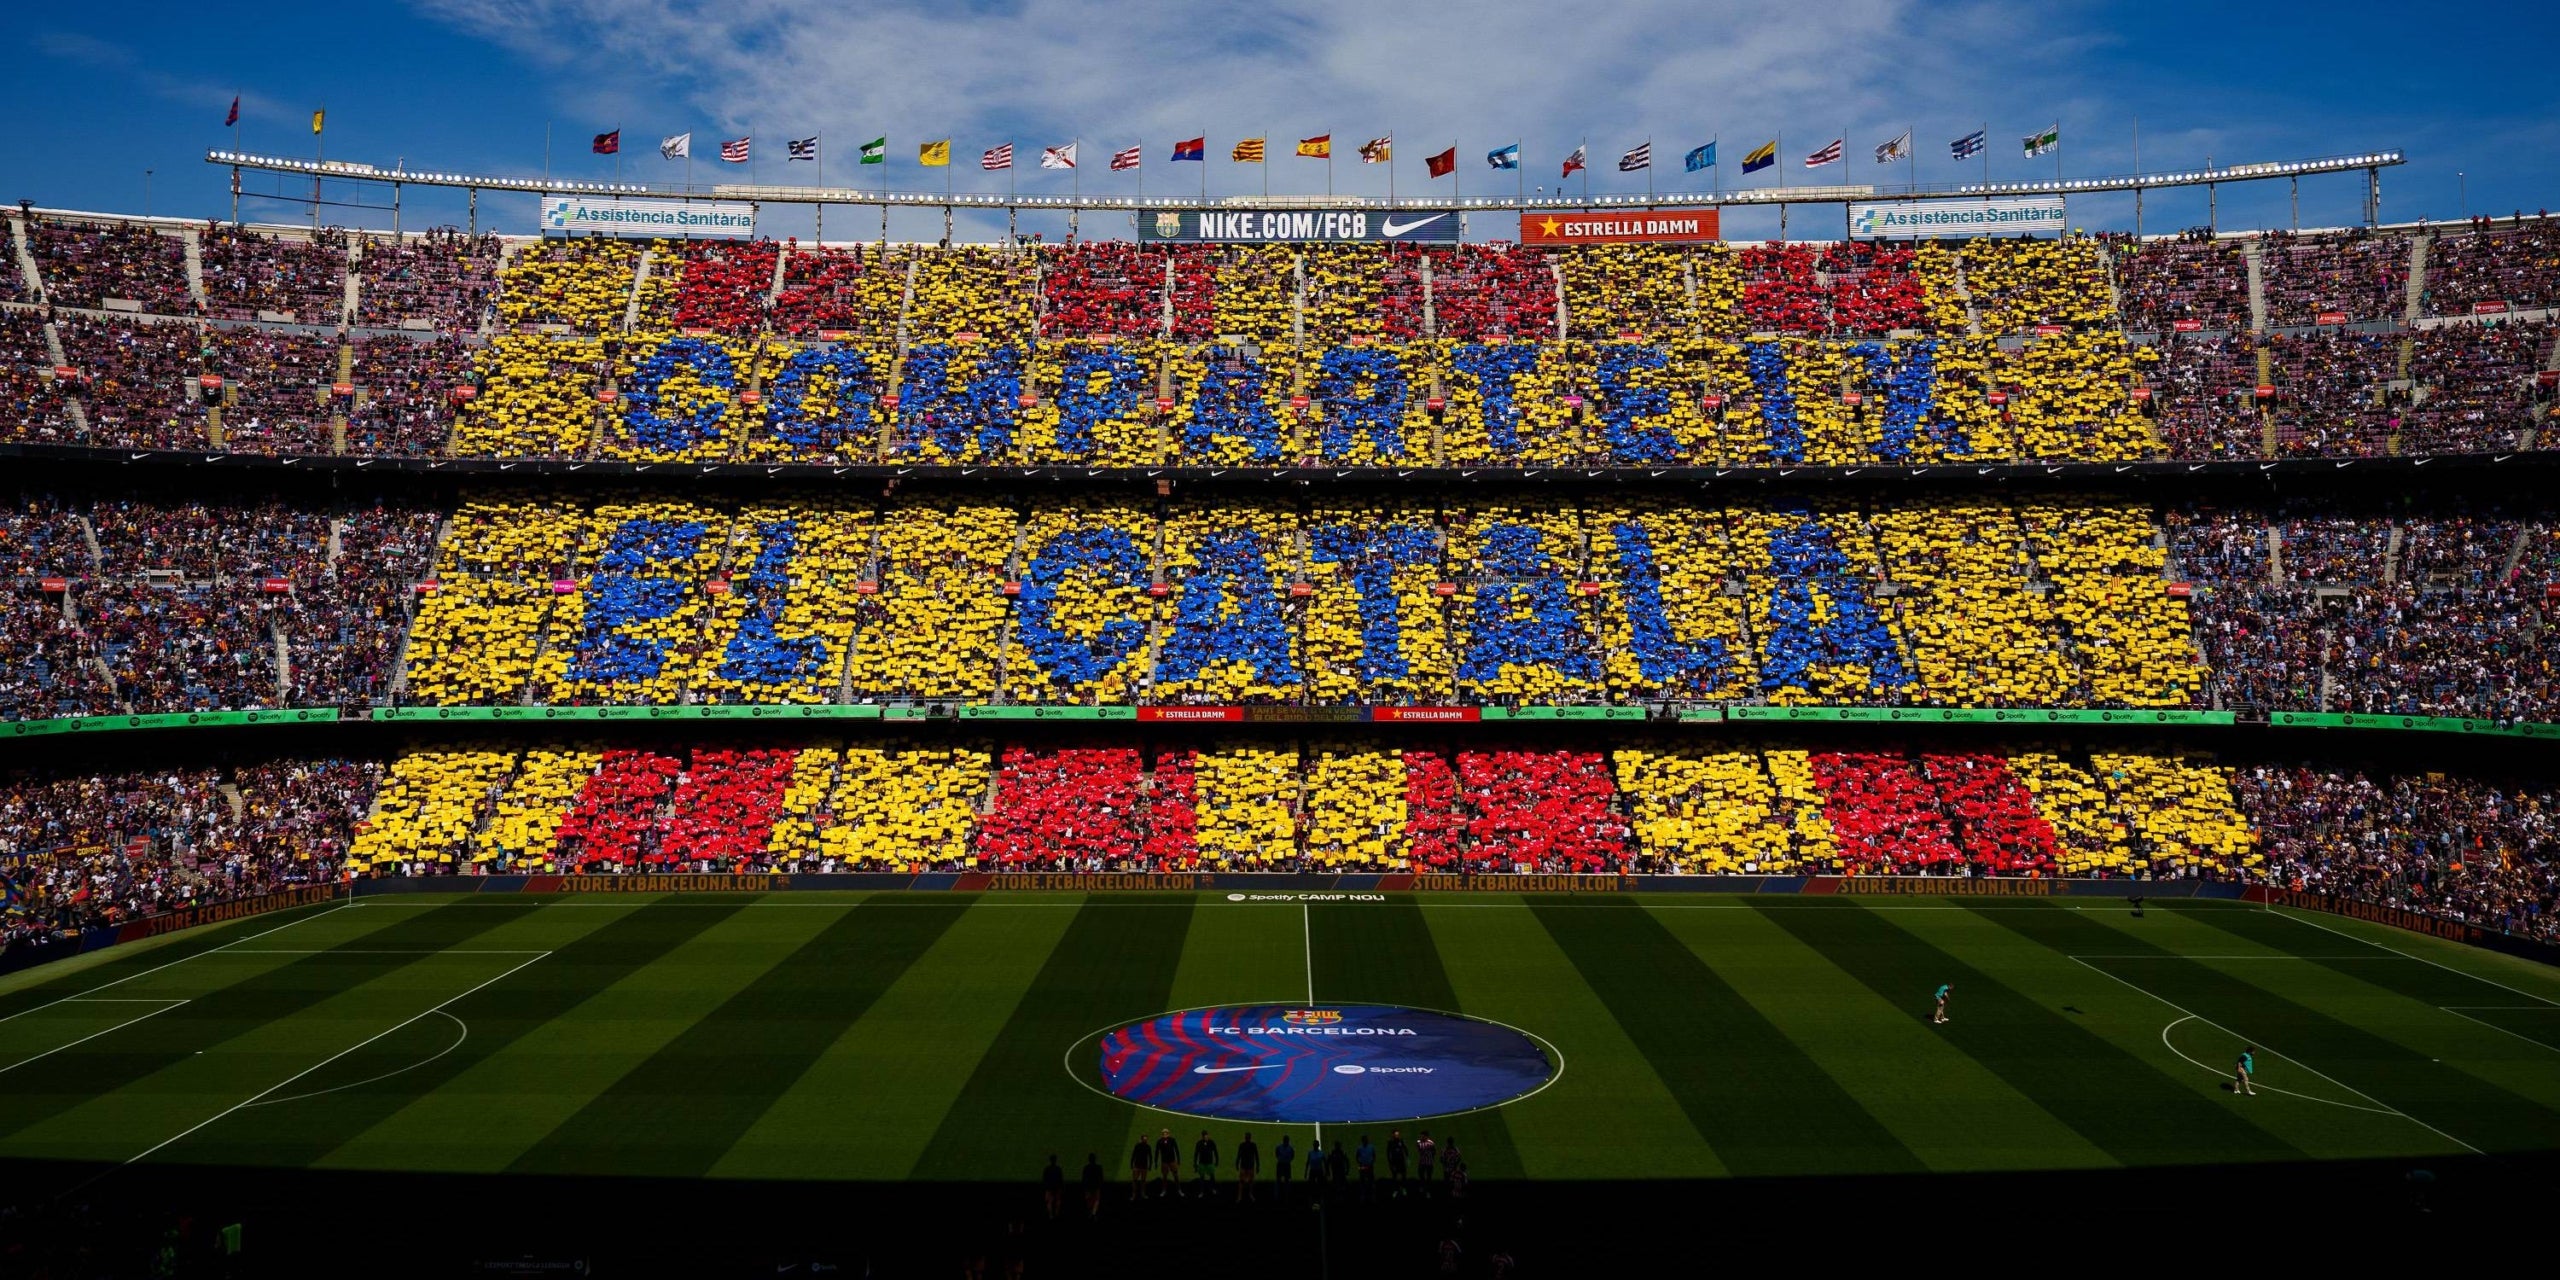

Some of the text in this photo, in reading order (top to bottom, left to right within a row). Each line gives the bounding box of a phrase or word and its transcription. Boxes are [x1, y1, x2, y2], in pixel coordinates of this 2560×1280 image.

[576, 205, 751, 227] Assistència Sanitària
[1884, 206, 2064, 226] Assistència Sanitària
[1199, 213, 1367, 239] NIKE.COM/FCB
[1564, 219, 1699, 236] ESTRELLA DAMM
[566, 517, 827, 683] EL
[309, 711, 331, 719] Spotify
[1166, 711, 1225, 719] ESTRELLA DAMM
[1404, 711, 1462, 719] ESTRELLA DAMM
[1953, 711, 1973, 719] Spotify
[562, 875, 770, 892] STORE.FCBARCELONA.COM
[991, 874, 1195, 890] STORE.FCBARCELONA.COM
[1413, 875, 1619, 892] STORE.FCBARCELONA.COM
[1839, 878, 2050, 896] STORE.FCBARCELONA.COM
[1249, 894, 1296, 902] Spotify
[149, 885, 334, 937] STORE.FCBARCELONA.COM
[2280, 892, 2465, 942] STORE.FCBARCELONA.COM
[1208, 1026, 1417, 1036] FC BARCELONA
[1370, 1066, 1434, 1075] Spotify
